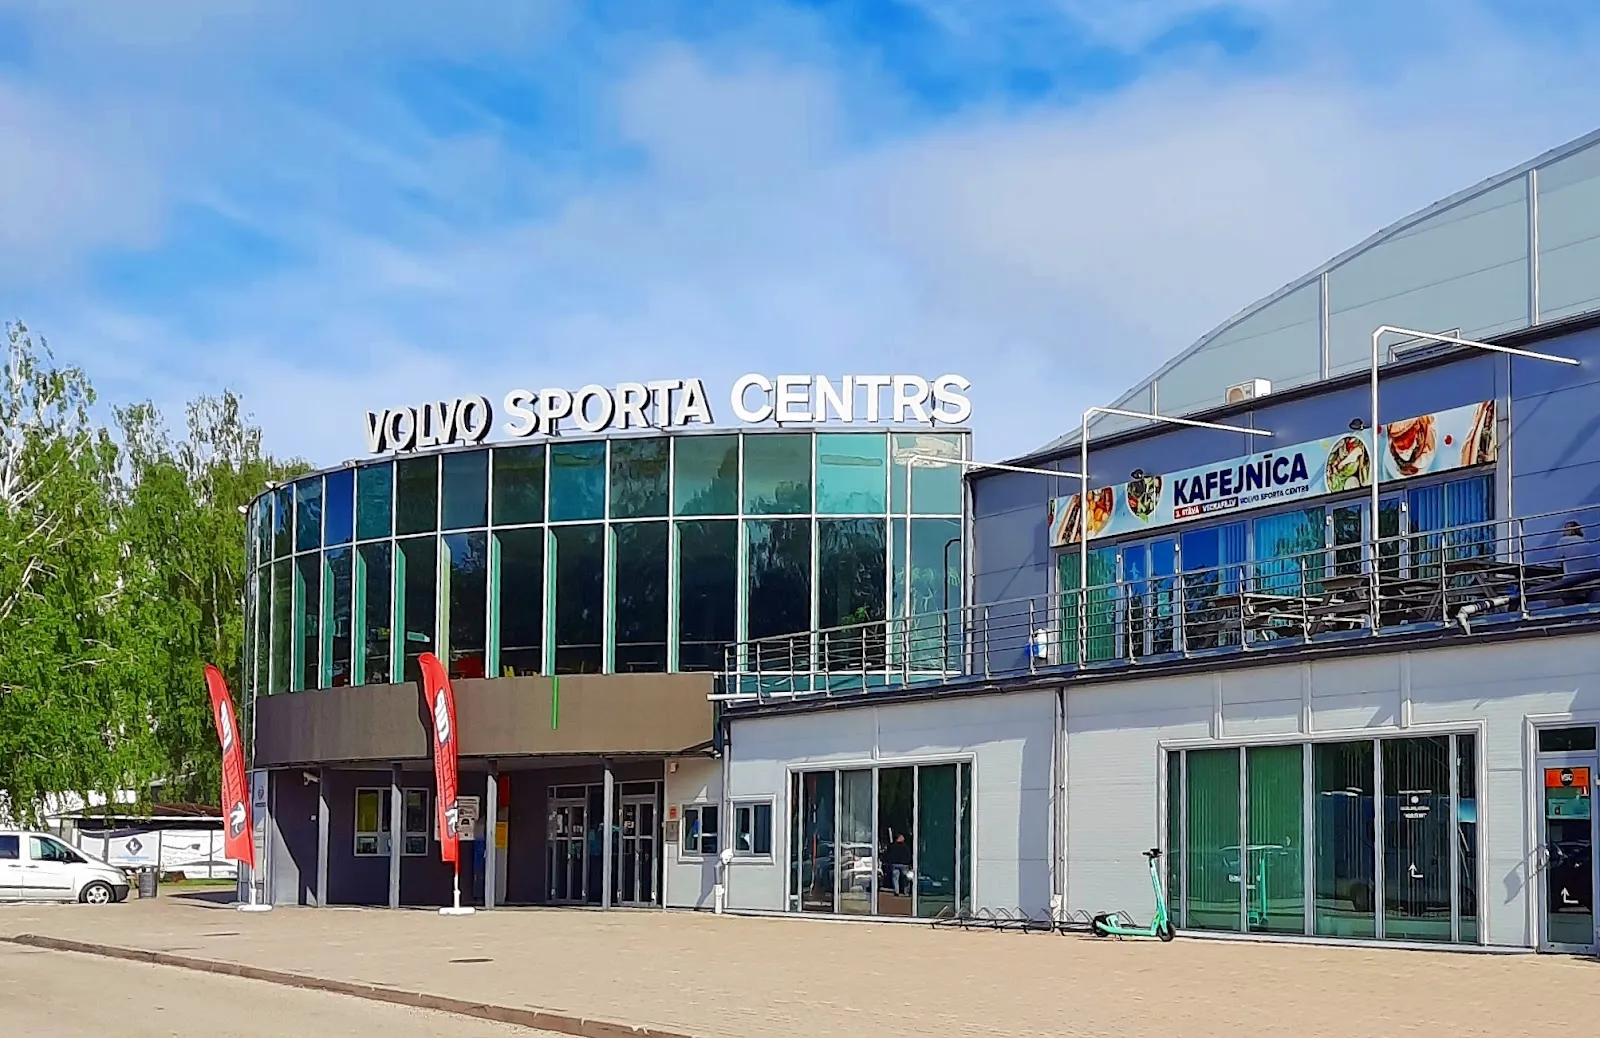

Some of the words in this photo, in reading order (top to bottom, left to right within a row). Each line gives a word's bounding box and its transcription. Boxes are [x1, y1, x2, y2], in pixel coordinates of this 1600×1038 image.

[365, 395, 491, 453] VOLVO
[504, 379, 713, 437] SPORTA
[731, 374, 972, 423] CENTRS
[1174, 452, 1309, 506] KAFEJNĪCA
[1261, 490, 1284, 501] SPORTA
[1285, 485, 1309, 496] CENTRS
